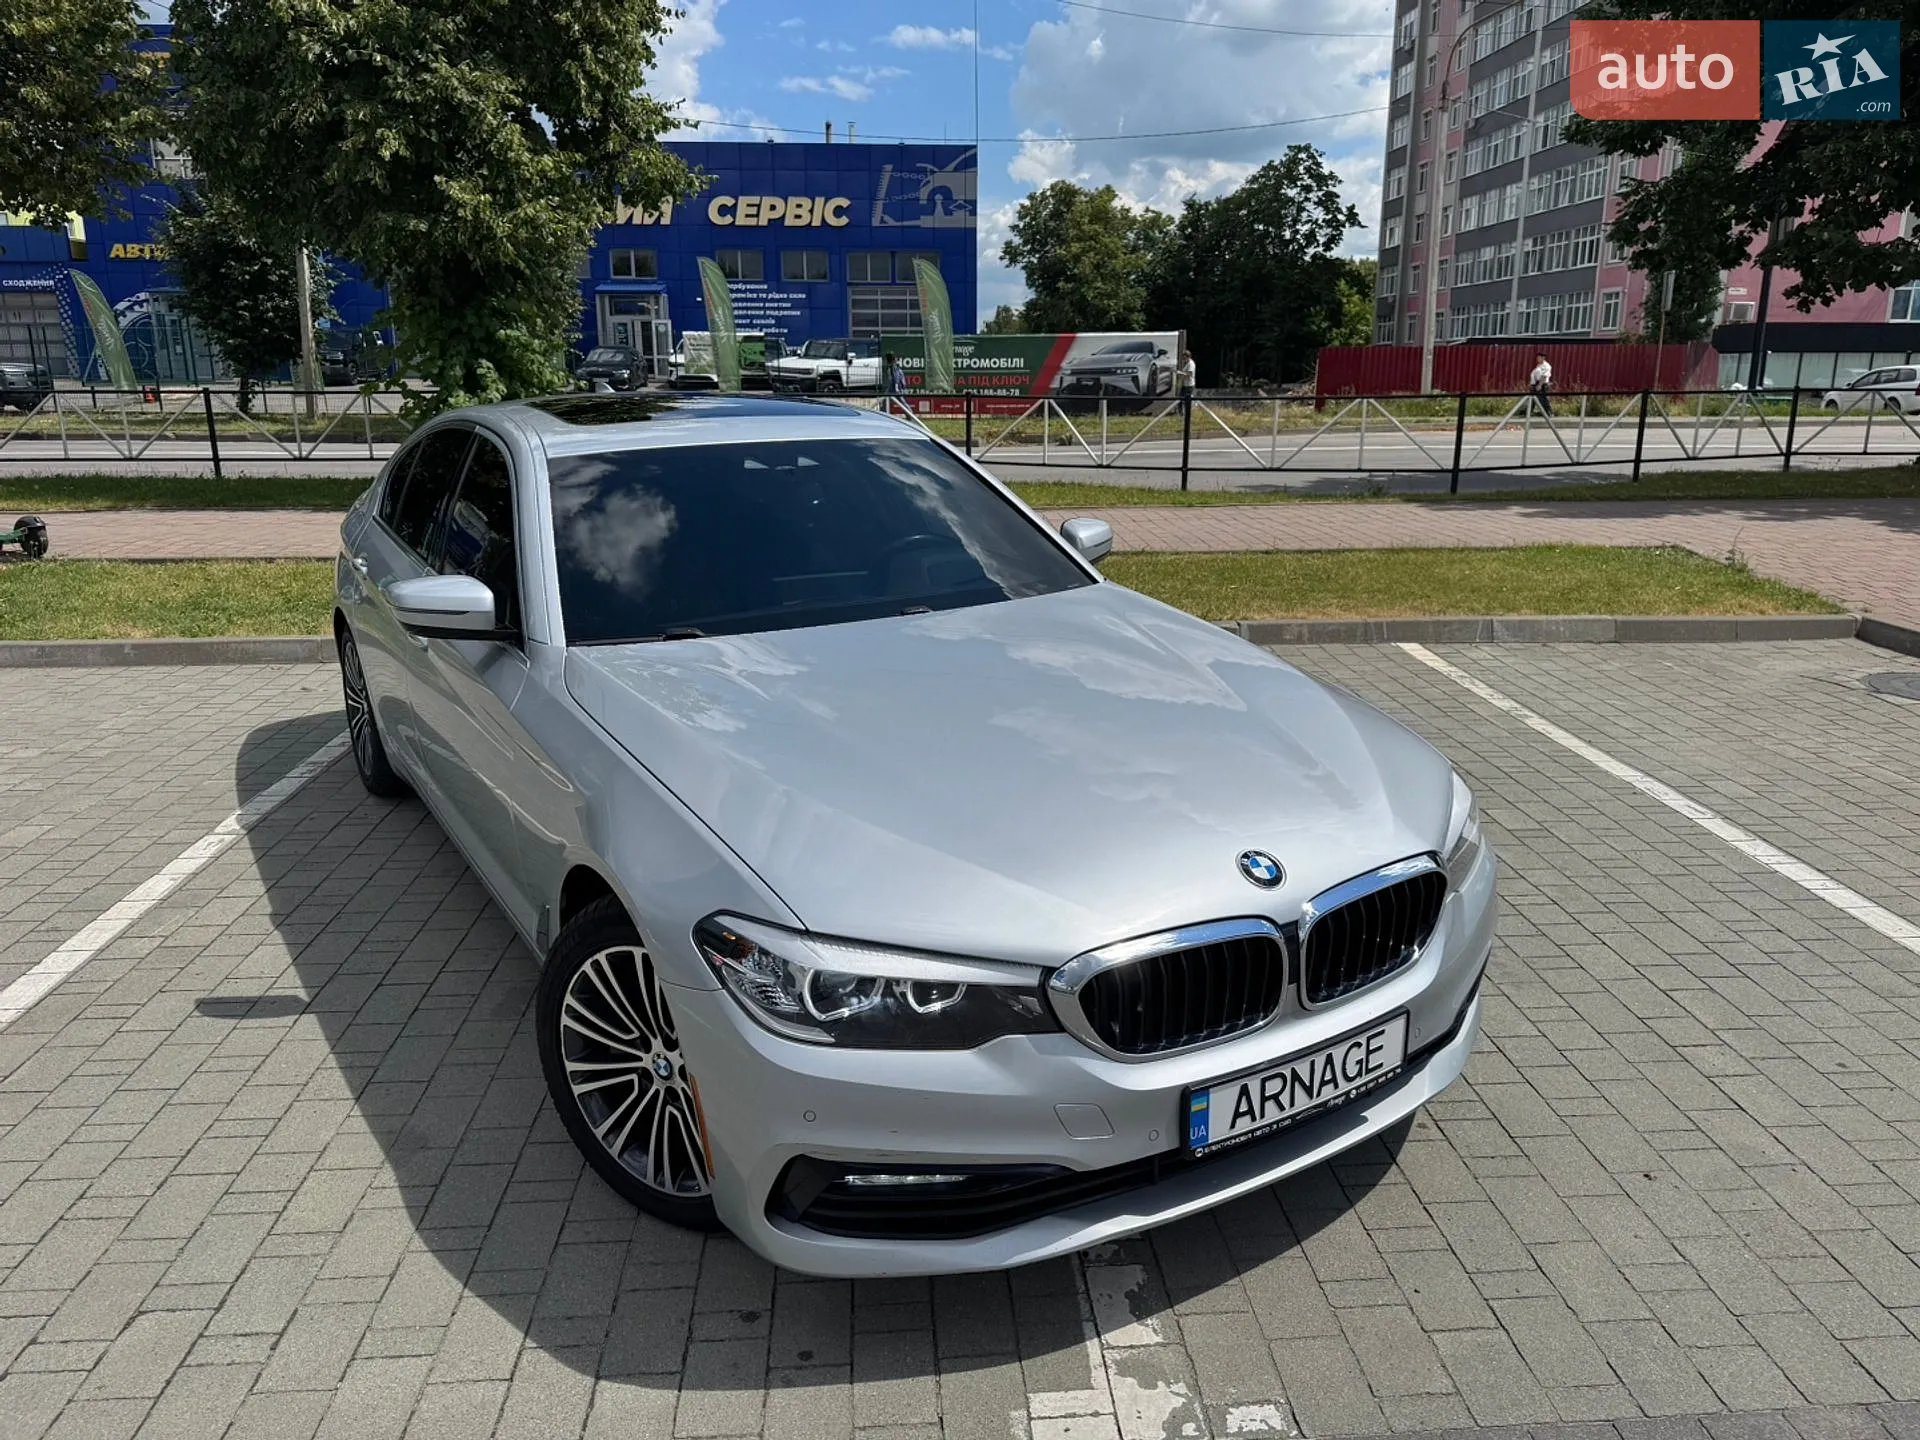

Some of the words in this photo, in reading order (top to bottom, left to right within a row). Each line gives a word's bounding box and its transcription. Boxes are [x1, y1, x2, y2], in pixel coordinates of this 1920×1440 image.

[708, 195, 851, 227] СЕРВІС
[1229, 1029, 1386, 1130] ARNAGE
[1190, 1125, 1207, 1140] UA
